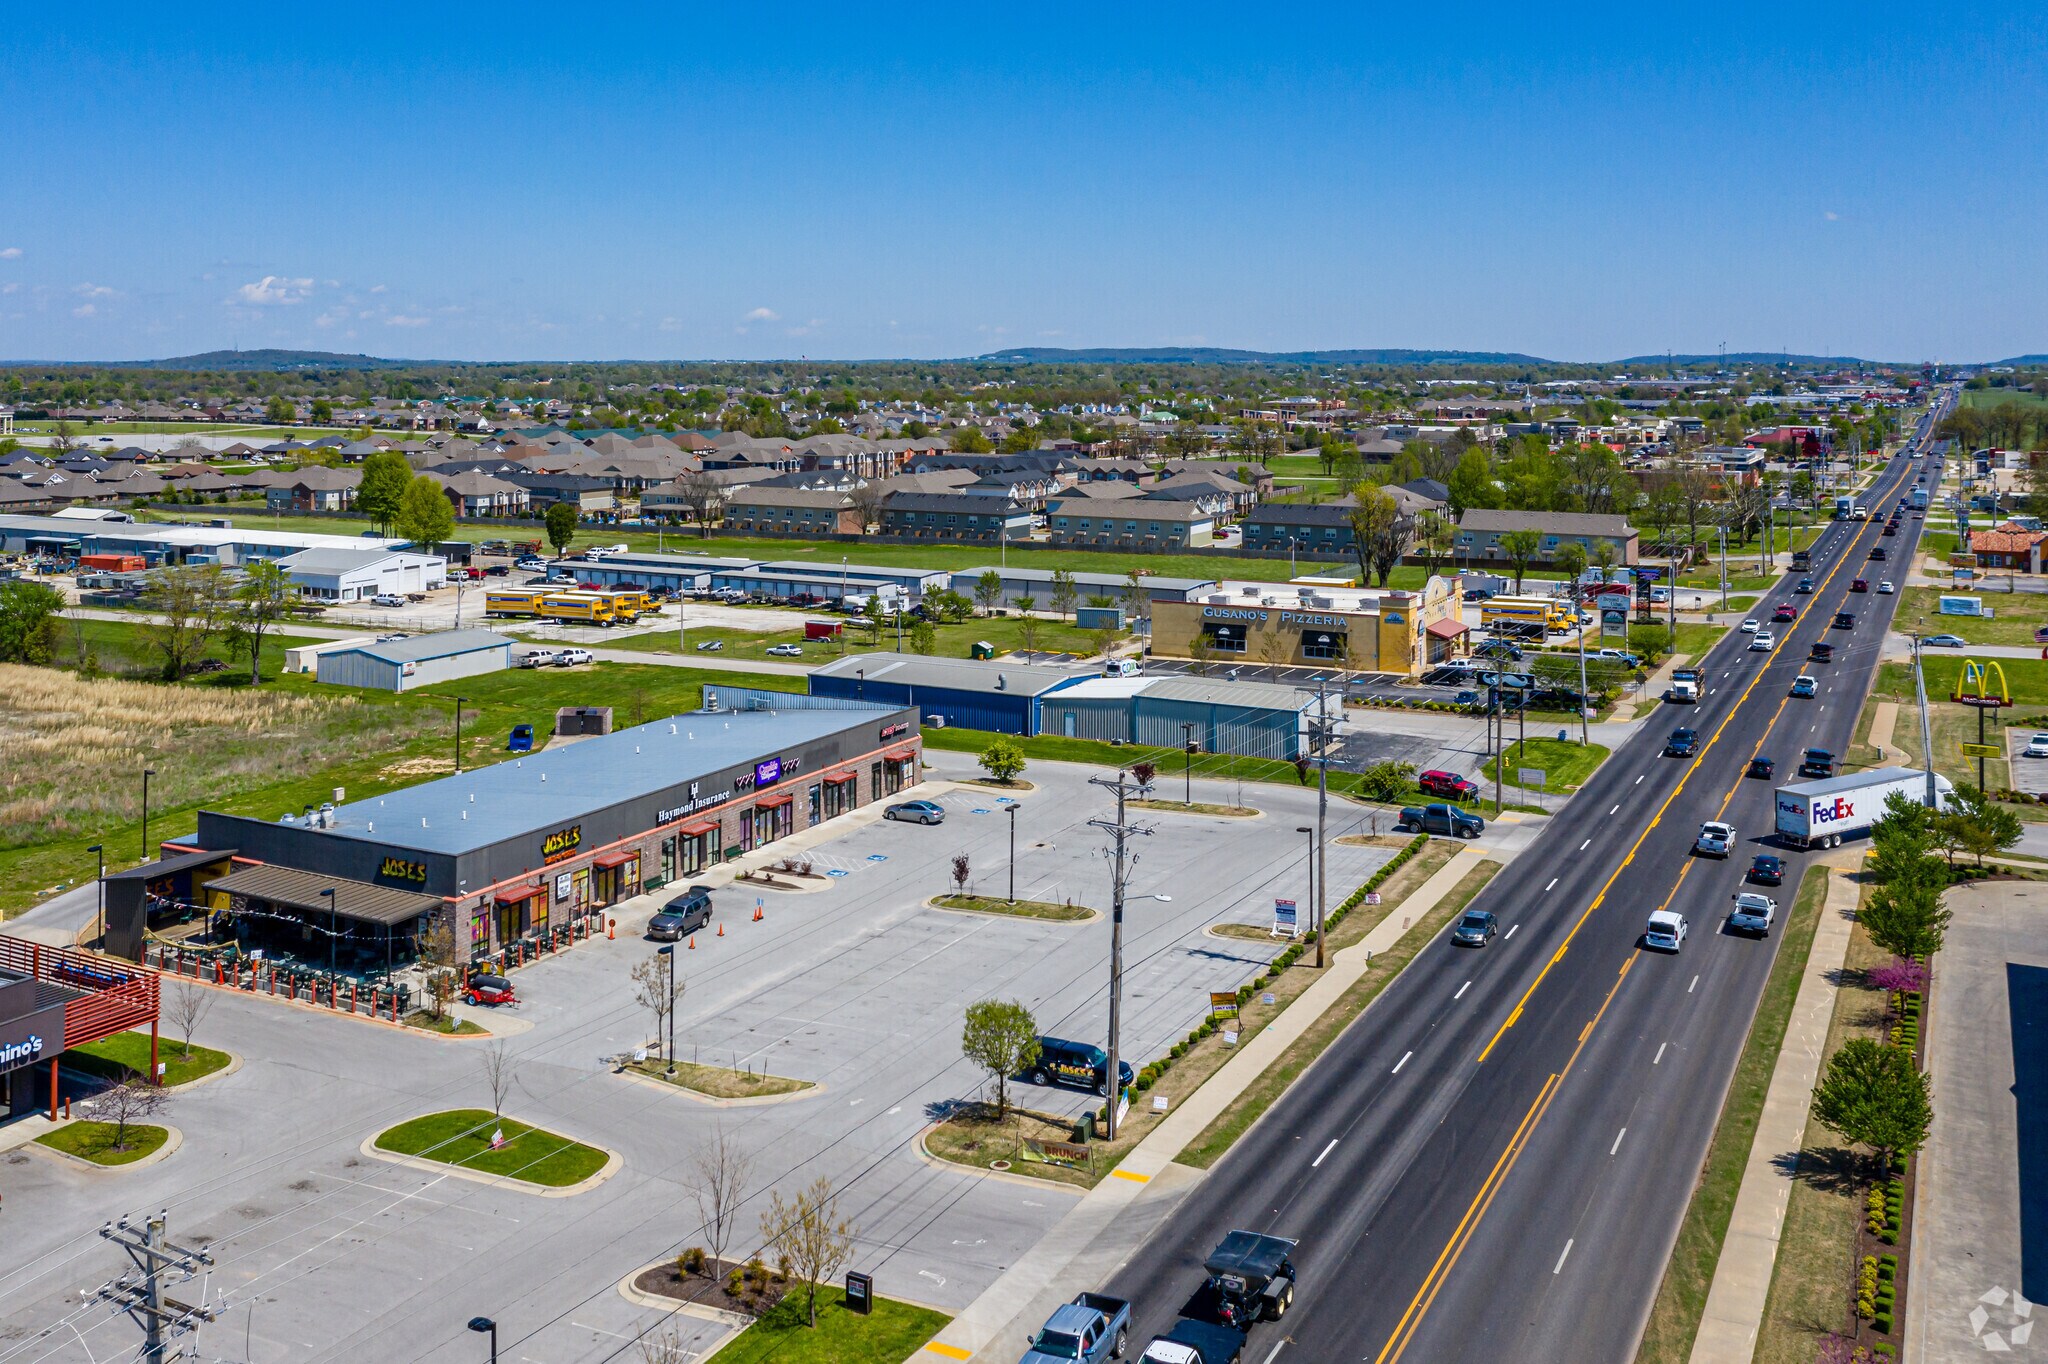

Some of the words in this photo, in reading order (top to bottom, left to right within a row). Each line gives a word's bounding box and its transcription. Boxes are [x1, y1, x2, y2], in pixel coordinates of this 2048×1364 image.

[1203, 606, 1268, 621] GUSANO'S
[1281, 611, 1347, 626] PIZZERIA
[658, 800, 694, 822] Haymond
[694, 790, 730, 810] Insurance
[1779, 801, 1805, 816] FedEx
[1812, 797, 1855, 825] FedEx
[1044, 1145, 1089, 1161] BRUNCH
